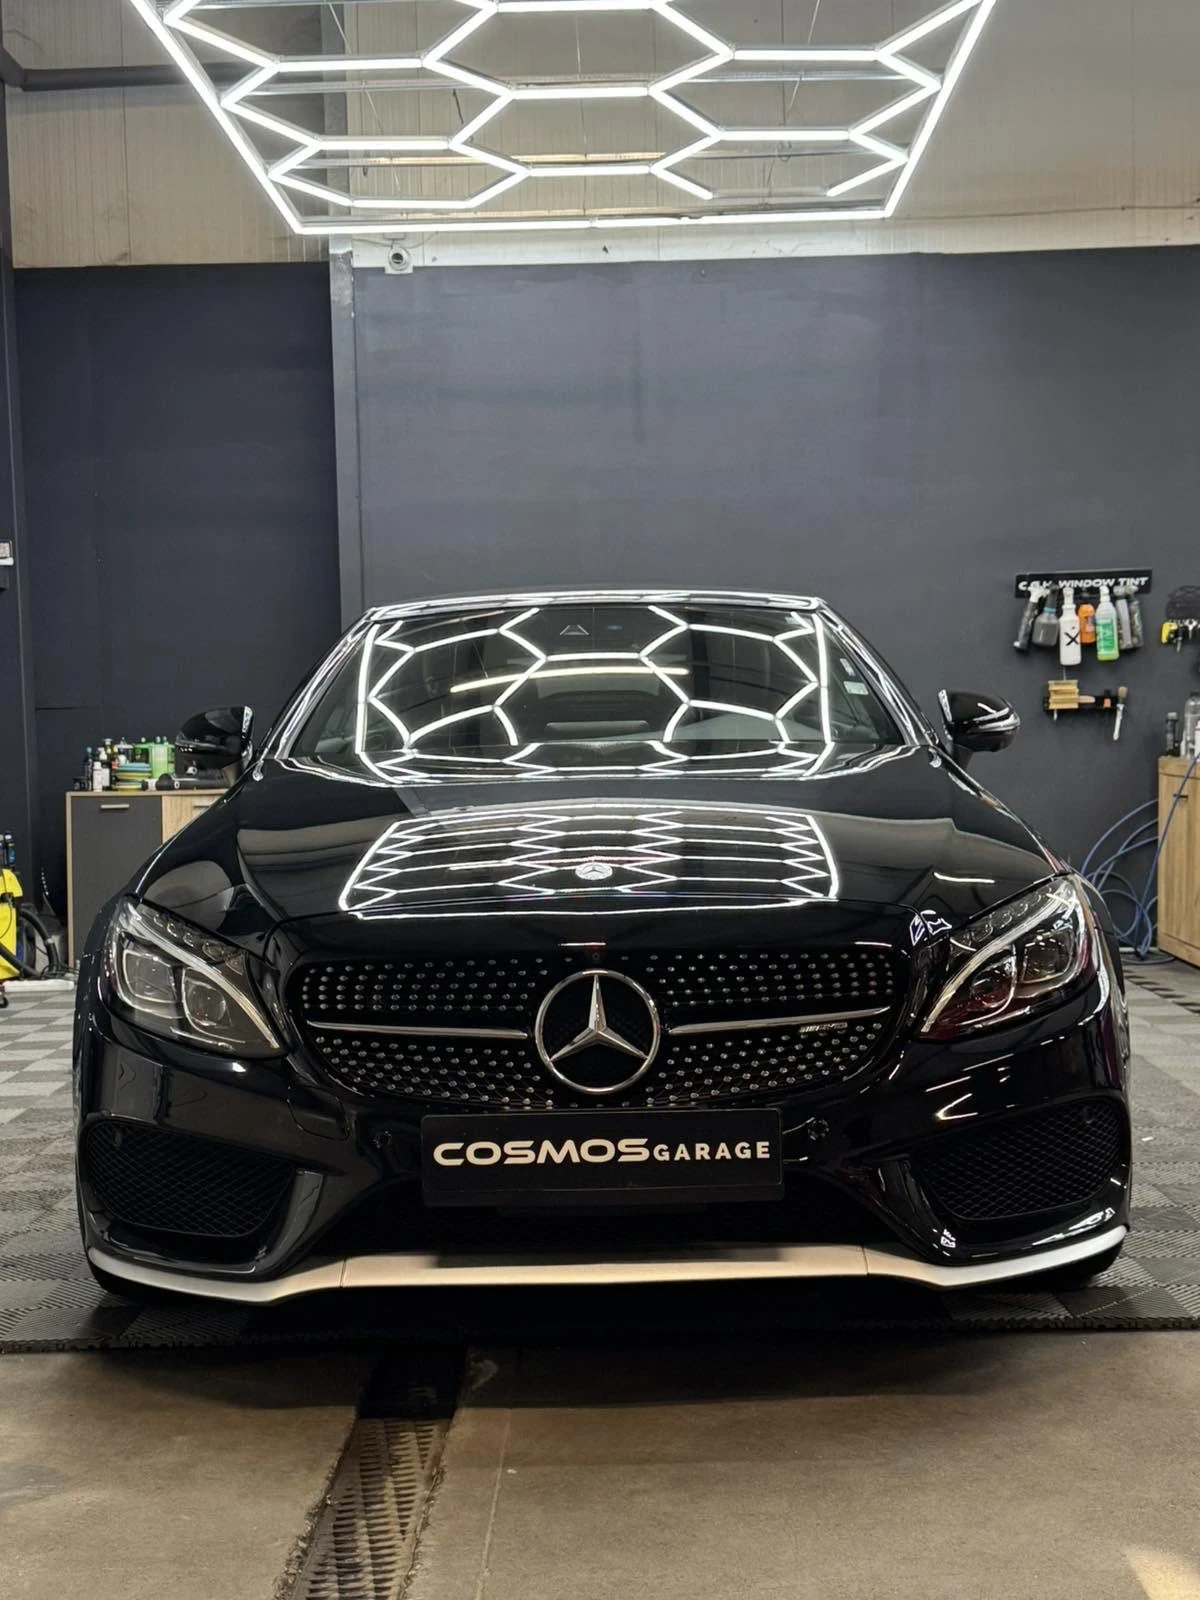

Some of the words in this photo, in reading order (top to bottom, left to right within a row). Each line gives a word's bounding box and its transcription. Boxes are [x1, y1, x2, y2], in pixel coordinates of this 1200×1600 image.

[1058, 578, 1116, 588] WINDOW
[1118, 576, 1149, 587] TINT
[433, 1138, 648, 1166] COSMOS
[653, 1141, 770, 1162] GARAGE
